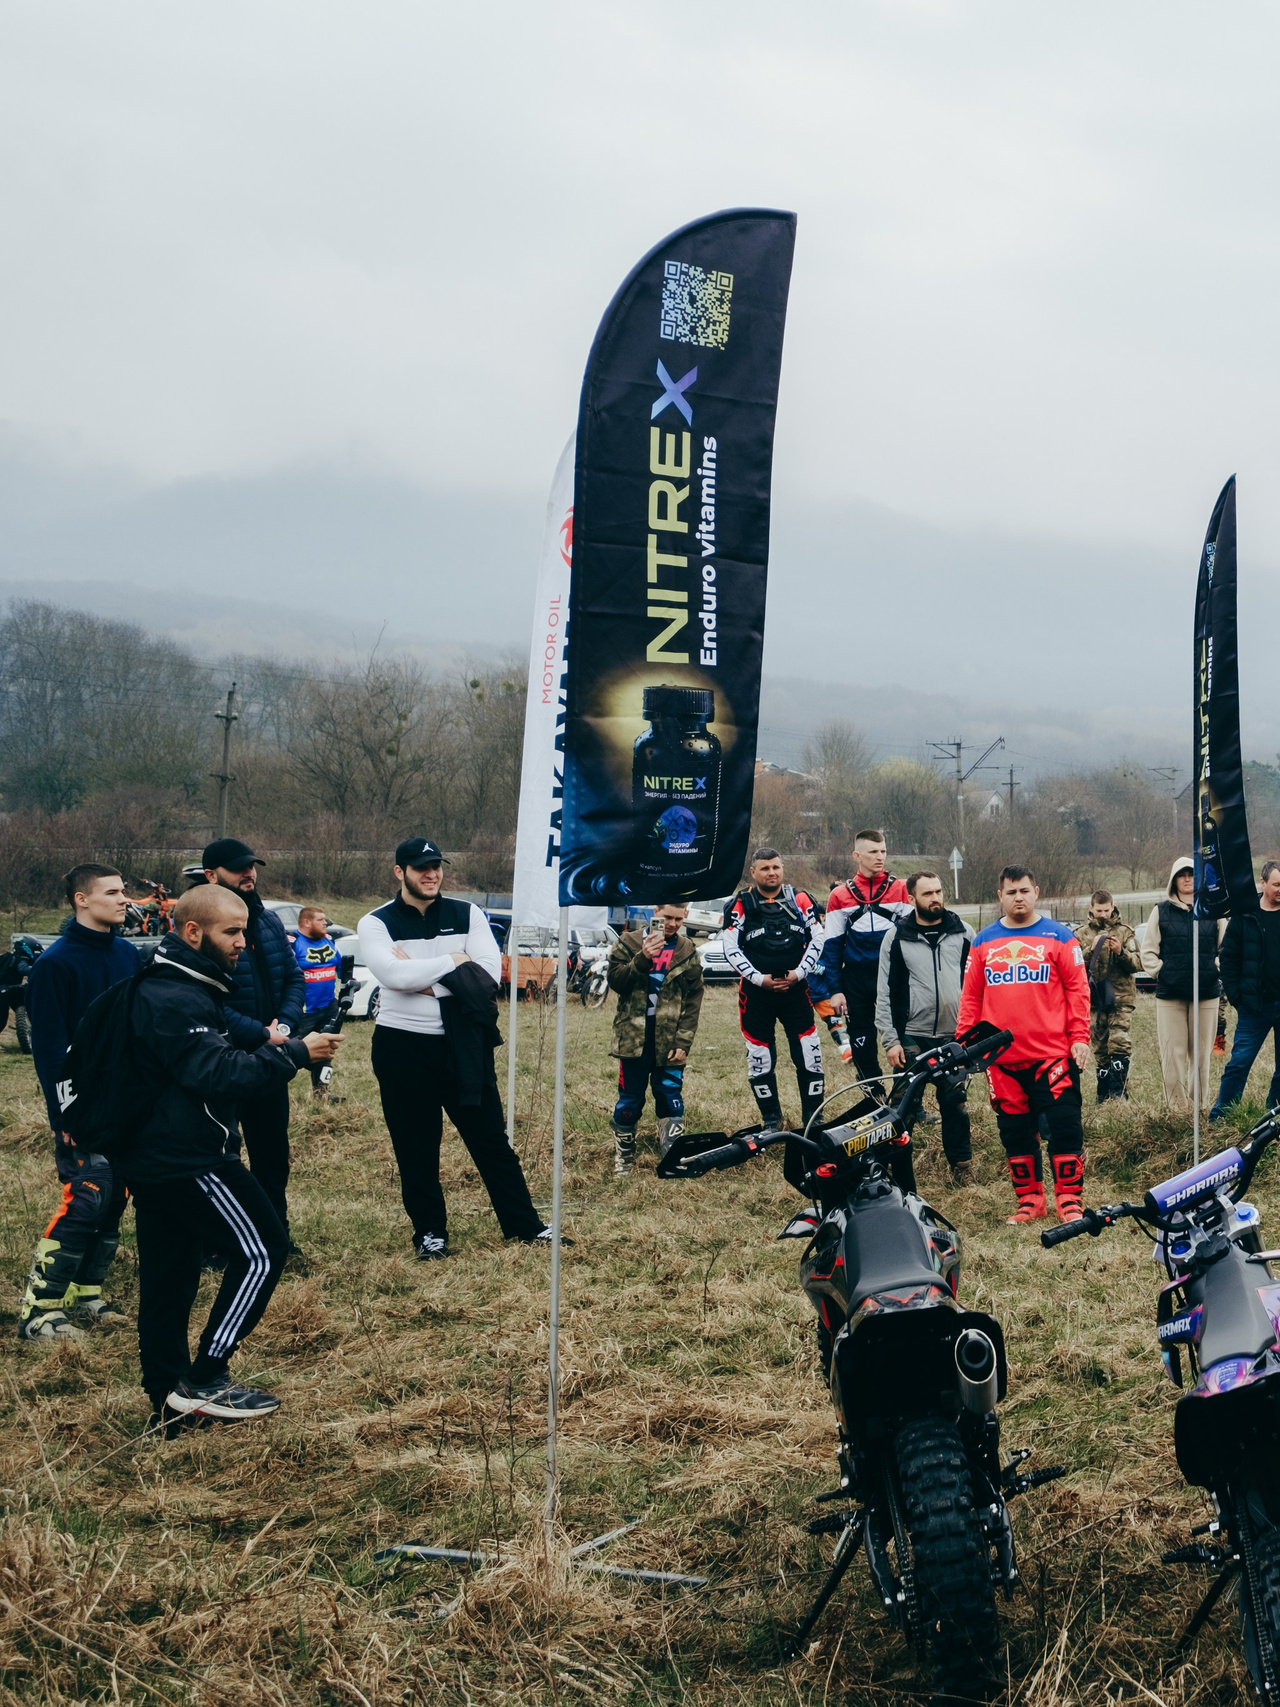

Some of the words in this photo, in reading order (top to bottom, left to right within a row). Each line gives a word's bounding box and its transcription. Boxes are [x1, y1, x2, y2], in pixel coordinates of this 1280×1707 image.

[696, 436, 718, 557] vitamins
[646, 358, 698, 664] NITREX
[548, 594, 562, 627] OIL
[698, 564, 718, 667] Enduro
[541, 632, 558, 704] MOTOR
[643, 775, 707, 791] NITREX
[304, 970, 336, 981] Suprem
[729, 951, 757, 979] FOX
[985, 965, 1013, 984] Red
[1017, 964, 1049, 983] Bull
[750, 1056, 763, 1078] FO
[56, 1079, 73, 1103] KE
[1164, 1162, 1239, 1208] SHARMAX
[1158, 1316, 1192, 1339] ARMAX
